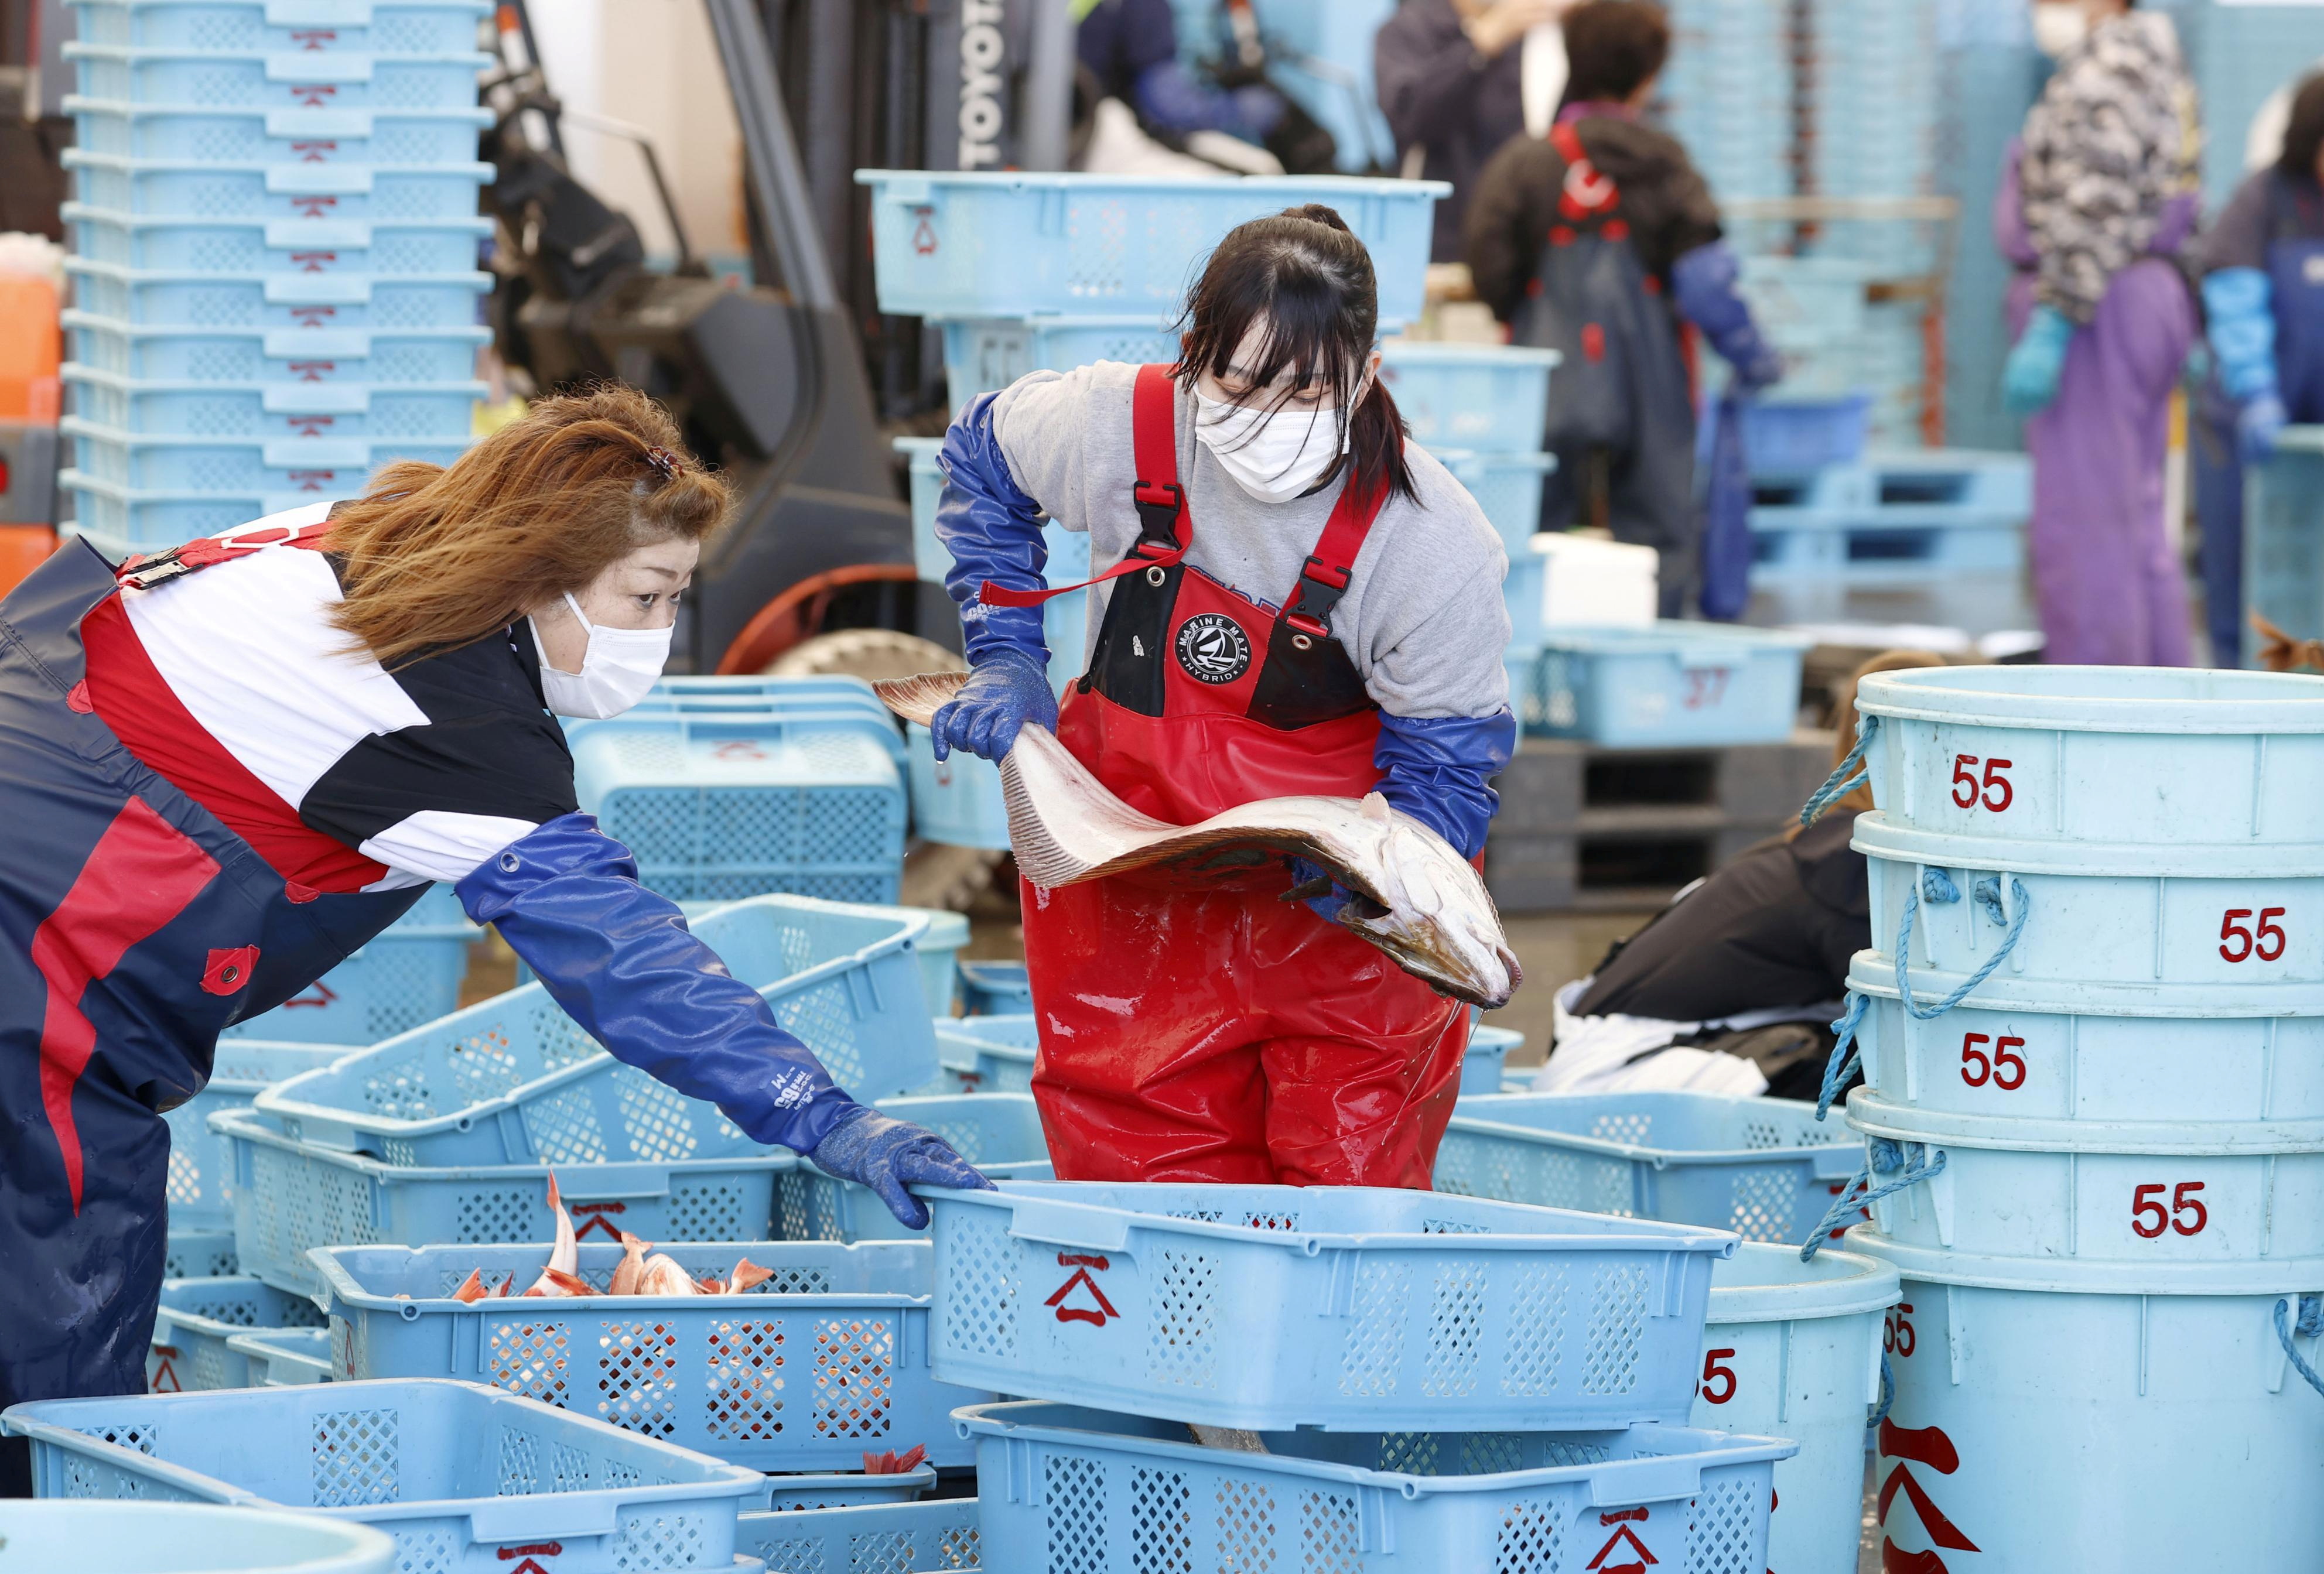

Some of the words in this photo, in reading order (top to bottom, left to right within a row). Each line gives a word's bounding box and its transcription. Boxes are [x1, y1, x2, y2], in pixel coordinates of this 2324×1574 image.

[958, 0, 1004, 170] TOYOT
[1179, 617, 1223, 646] MARINE
[1229, 626, 1248, 662] MATE
[1185, 662, 1232, 682] HYBRID
[1953, 755, 2012, 812] 55
[2219, 908, 2285, 962] 55
[771, 1073, 787, 1090] M
[1962, 1033, 2025, 1090] 55
[774, 1087, 800, 1110] 65
[2133, 1182, 2207, 1237] 55
[1695, 1348, 1737, 1405] 5
